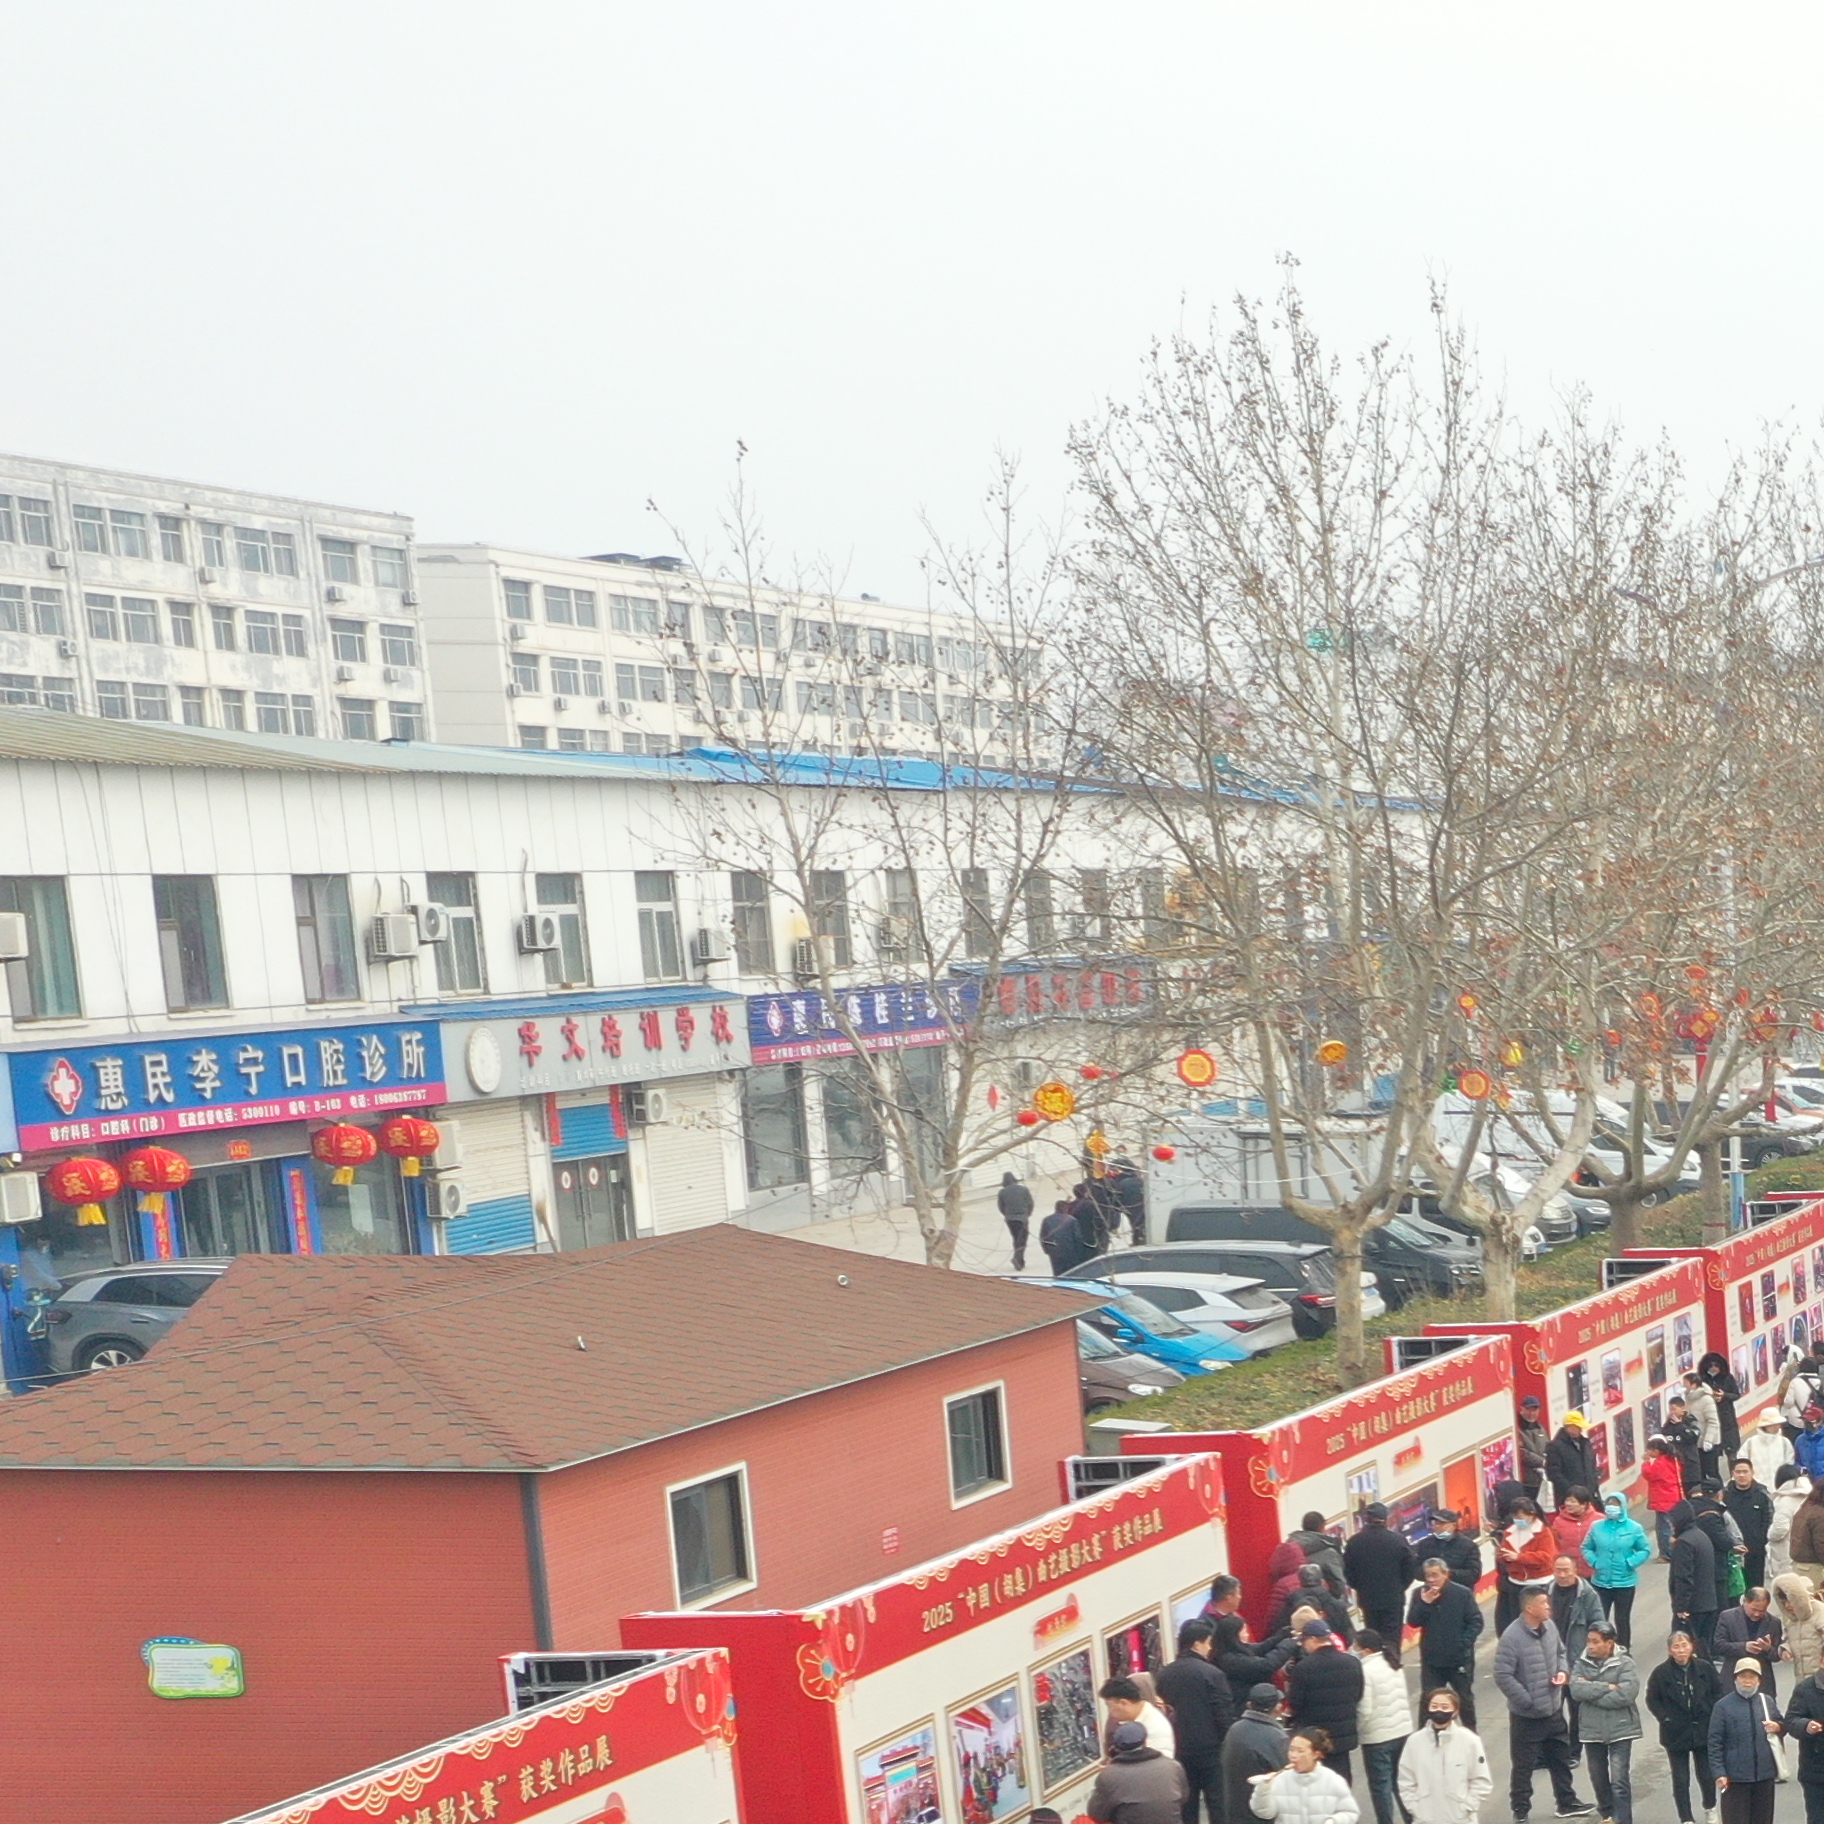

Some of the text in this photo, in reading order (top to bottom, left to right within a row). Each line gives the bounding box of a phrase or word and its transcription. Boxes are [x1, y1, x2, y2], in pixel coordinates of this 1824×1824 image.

[93, 1031, 427, 1111] 惠民李宁口腔诊所
[517, 1005, 735, 1068] 华文培训学校
